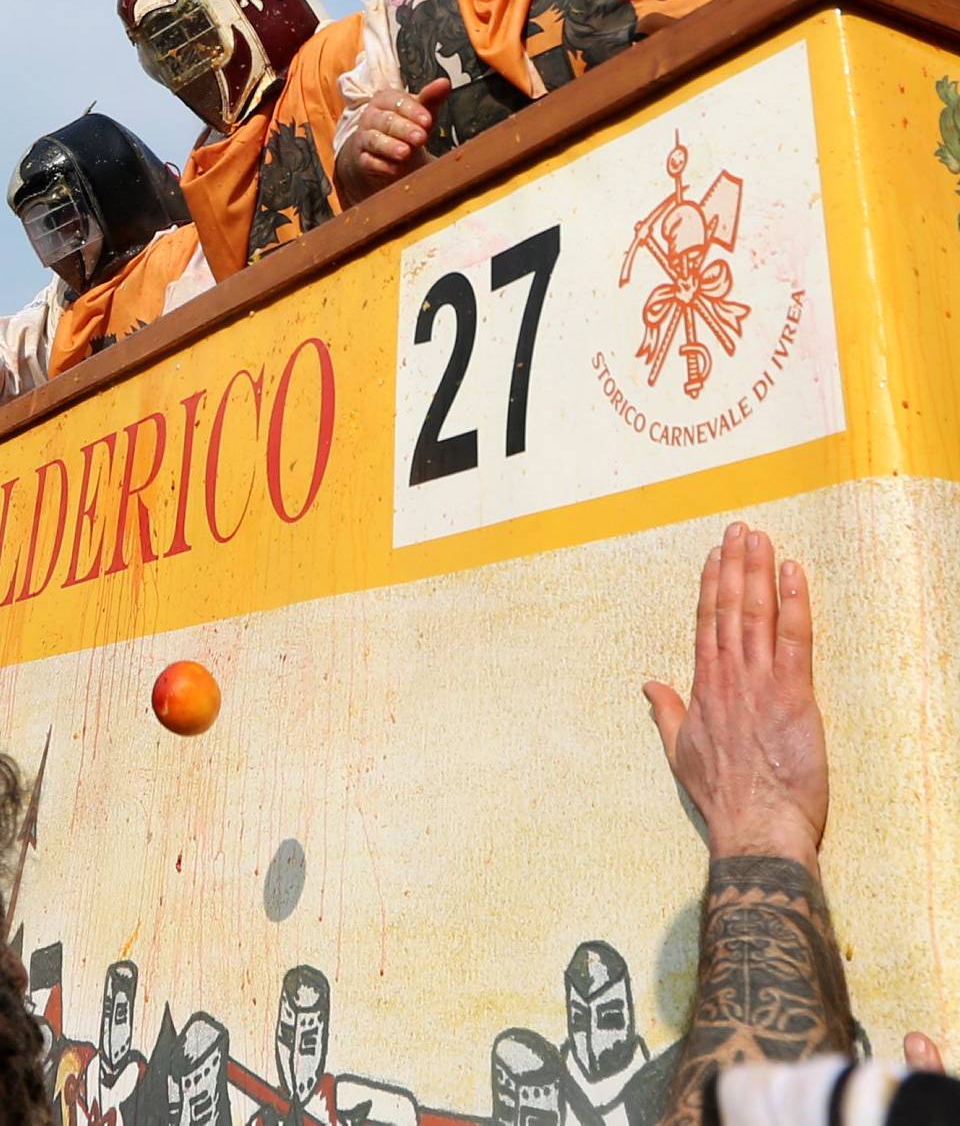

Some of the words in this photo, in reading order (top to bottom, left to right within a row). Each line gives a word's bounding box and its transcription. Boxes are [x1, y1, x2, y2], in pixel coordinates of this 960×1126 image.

[409, 224, 561, 487] 27
[592, 351, 646, 433] STORICO
[649, 396, 753, 447] CARNEVALE
[752, 370, 775, 402] DI
[771, 289, 806, 370] IVREA
